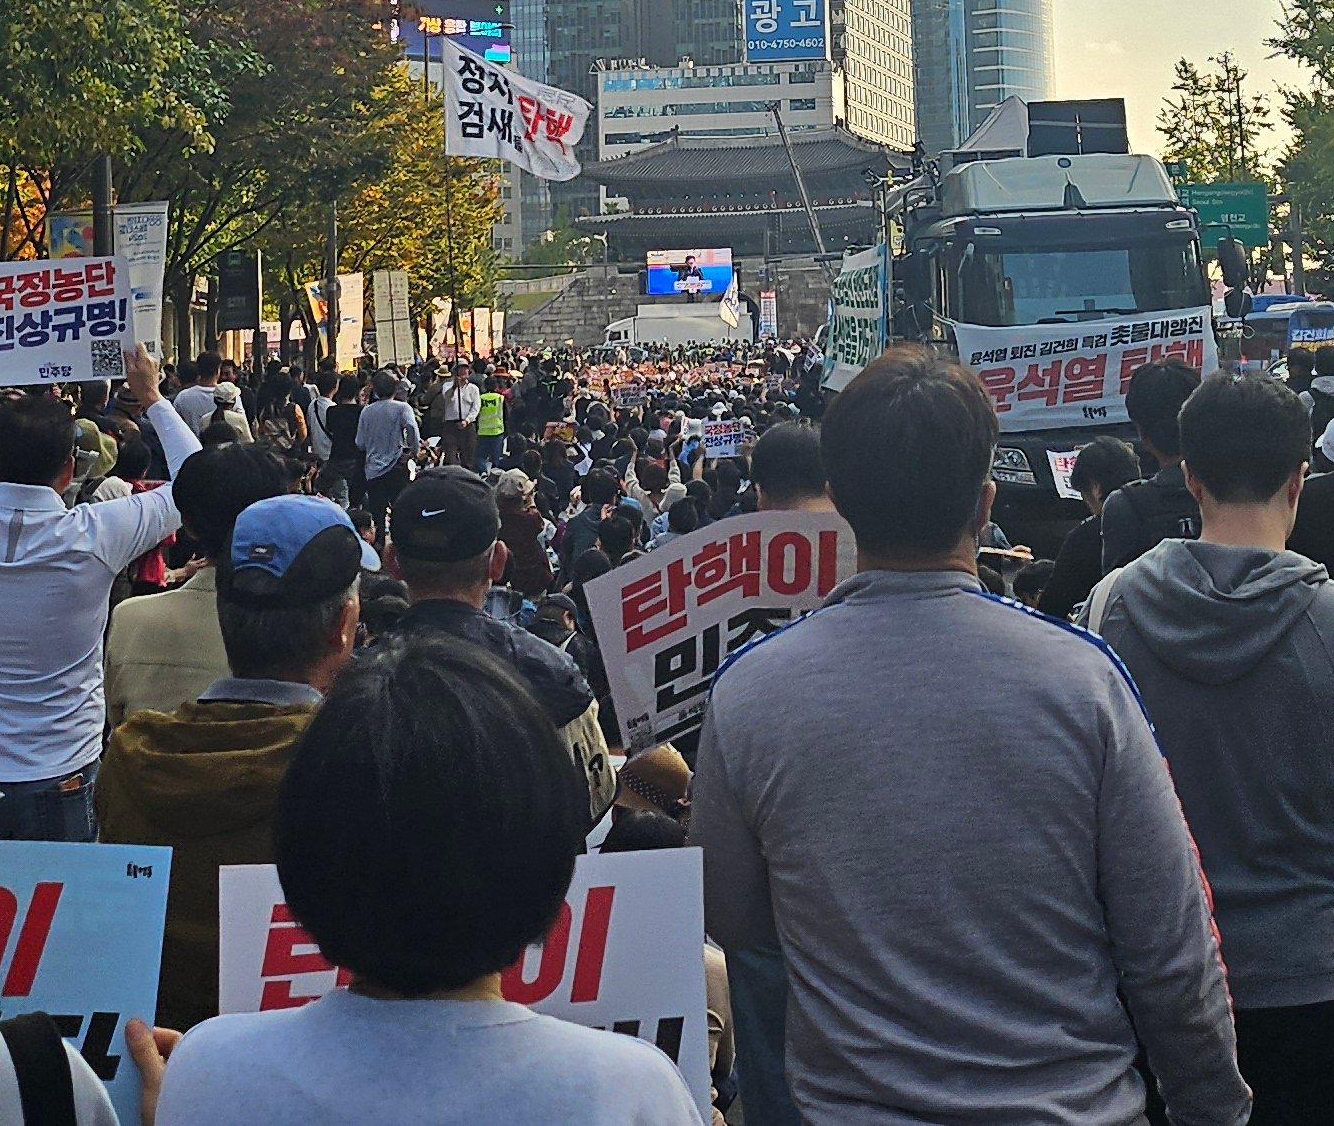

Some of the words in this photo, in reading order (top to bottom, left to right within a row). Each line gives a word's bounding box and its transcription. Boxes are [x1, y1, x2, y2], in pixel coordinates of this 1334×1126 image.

[748, 37, 824, 50] 010-4750-4602
[516, 95, 574, 156] 탄핵
[970, 347, 1008, 366] 윤석열
[1010, 344, 1037, 361] 퇴진
[1040, 337, 1079, 355] 김건희
[1081, 333, 1108, 349] 특검
[1110, 316, 1204, 347] 촛불대행진
[38, 365, 73, 379] 민주당
[979, 353, 1107, 413] 윤석열
[621, 530, 838, 654] 탄핵이
